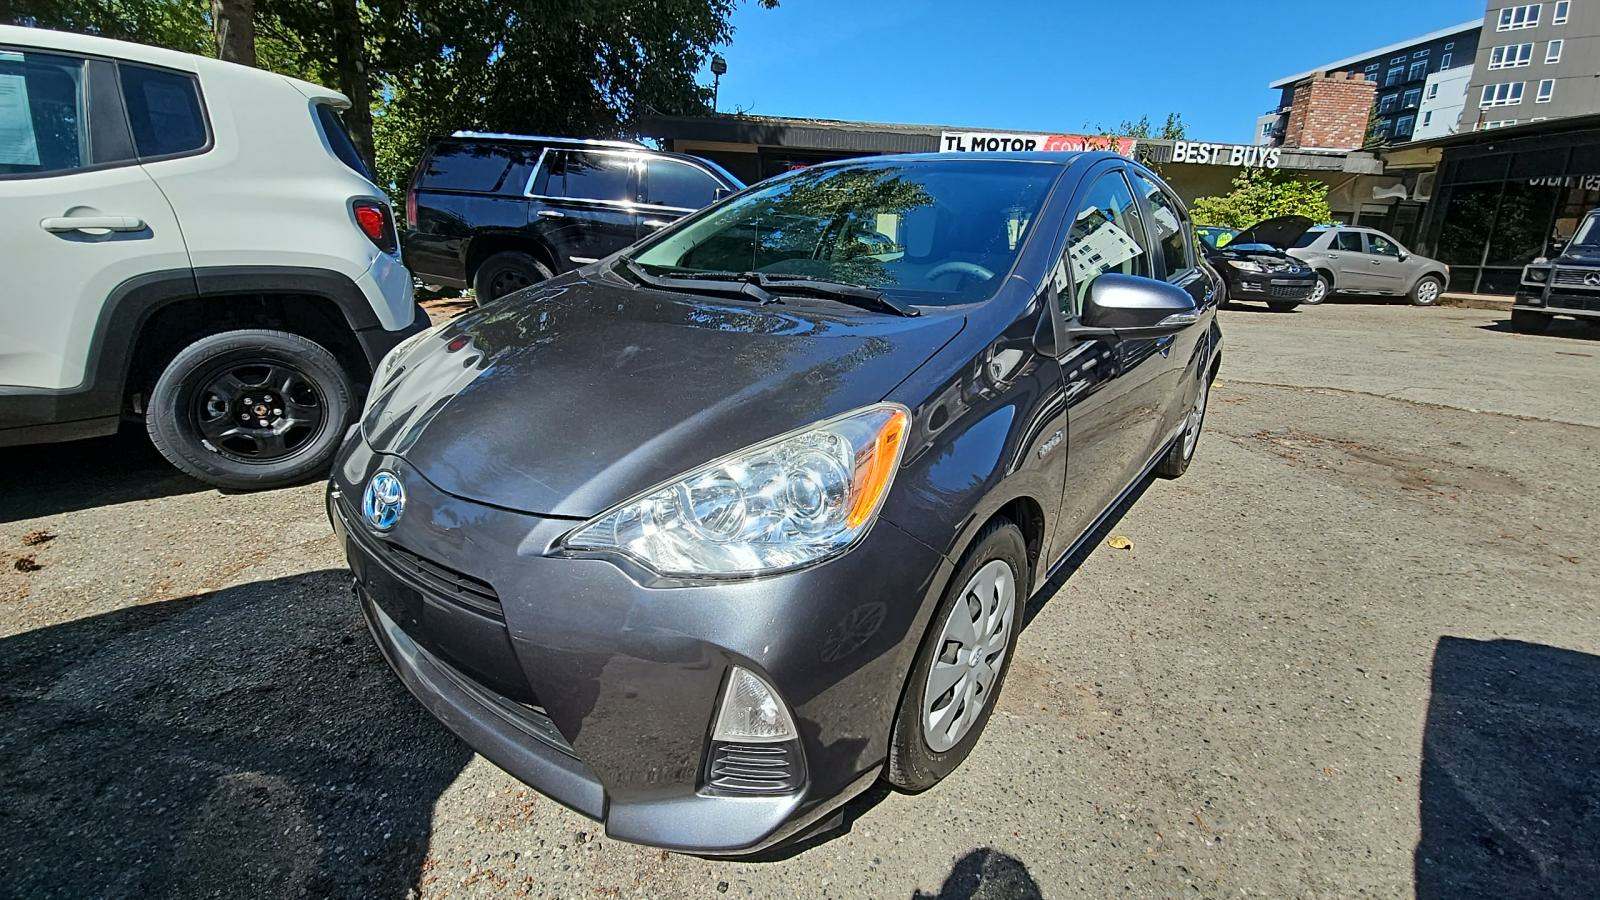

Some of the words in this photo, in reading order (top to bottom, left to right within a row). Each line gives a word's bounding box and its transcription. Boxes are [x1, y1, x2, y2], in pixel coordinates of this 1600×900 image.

[945, 136, 966, 152] TL
[971, 137, 1036, 152] MOTOR
[1172, 141, 1222, 164] BEST
[1229, 145, 1281, 168] BUYS
